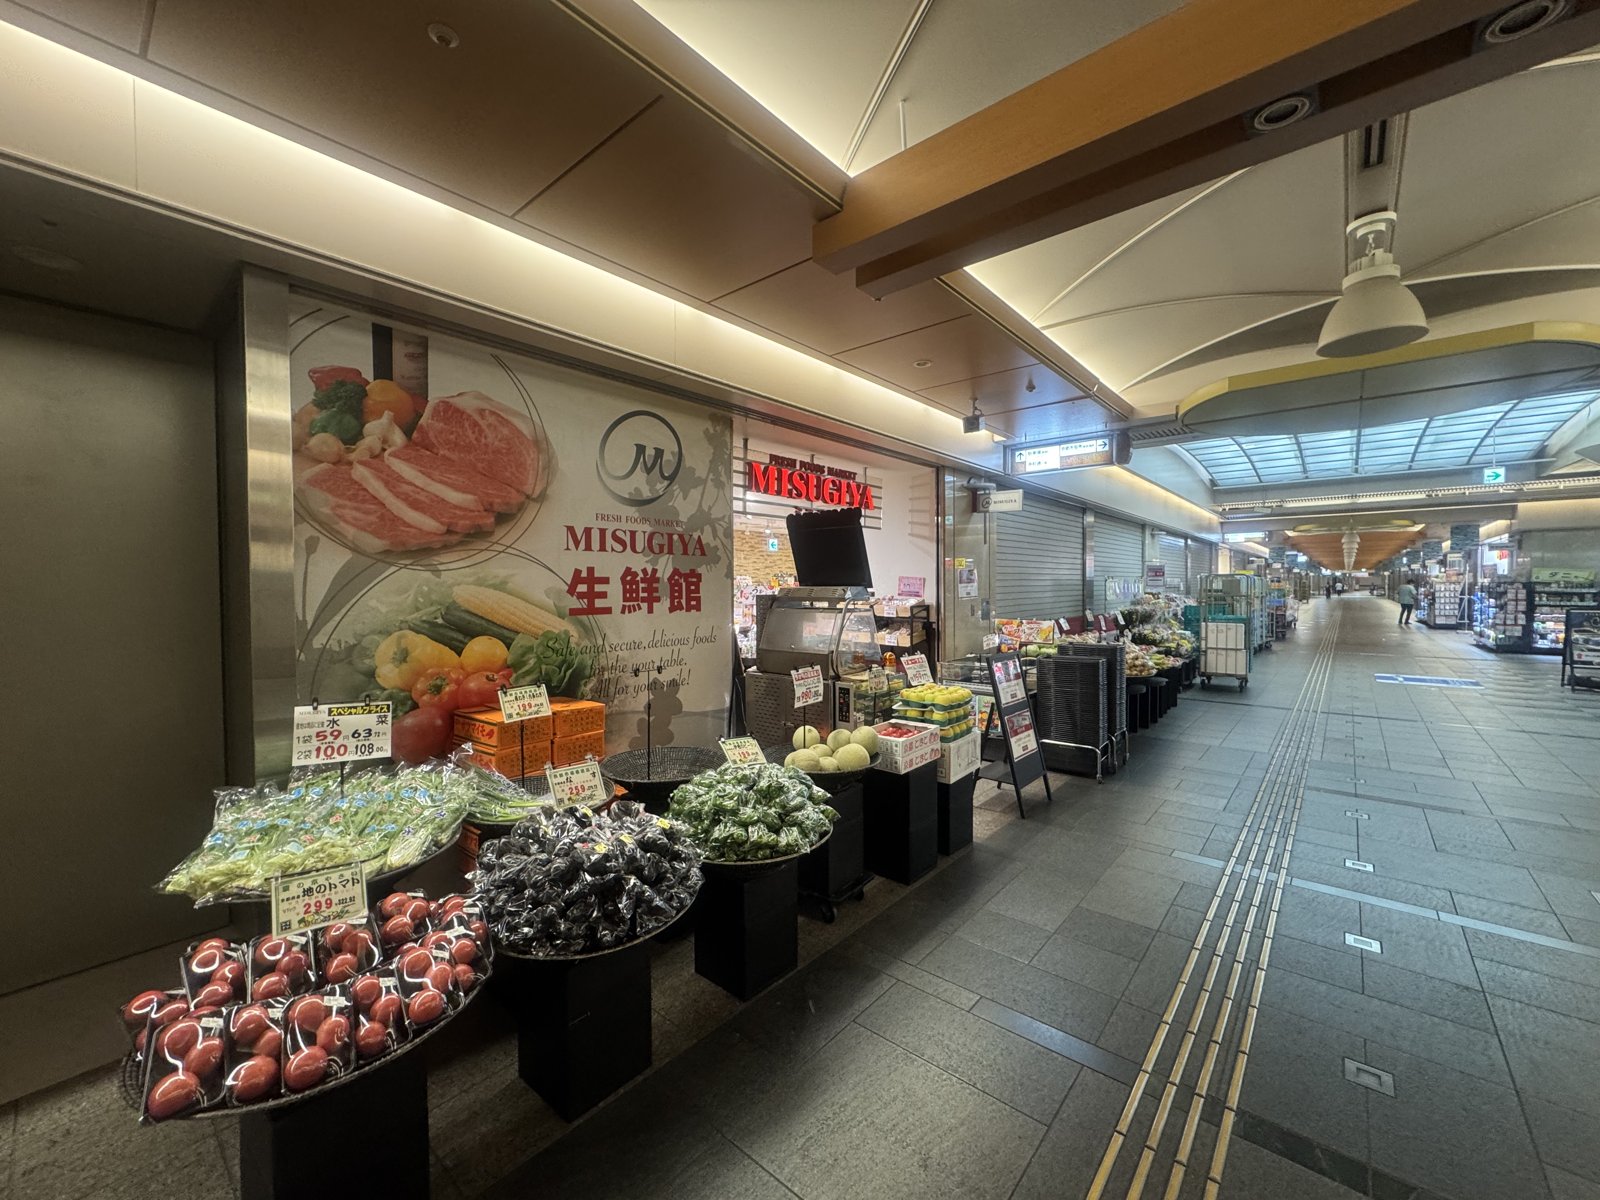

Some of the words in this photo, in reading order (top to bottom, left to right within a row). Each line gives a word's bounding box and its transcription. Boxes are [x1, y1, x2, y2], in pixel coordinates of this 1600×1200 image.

[748, 461, 875, 510] MISUGIYA
[595, 512, 622, 523] FRESH
[625, 515, 651, 525] FOODS
[653, 518, 685, 529] MARKET
[563, 525, 708, 557] MISUGIYA
[566, 566, 703, 617] 生鮮館
[542, 634, 576, 661] Safe
[580, 633, 607, 655] and
[691, 626, 718, 650] foods
[610, 654, 628, 675] the
[657, 648, 688, 669] table.
[612, 675, 630, 702] for
[633, 677, 657, 699] your
[660, 668, 692, 689] smile!
[568, 784, 586, 795] 259
[303, 897, 333, 915] 299
